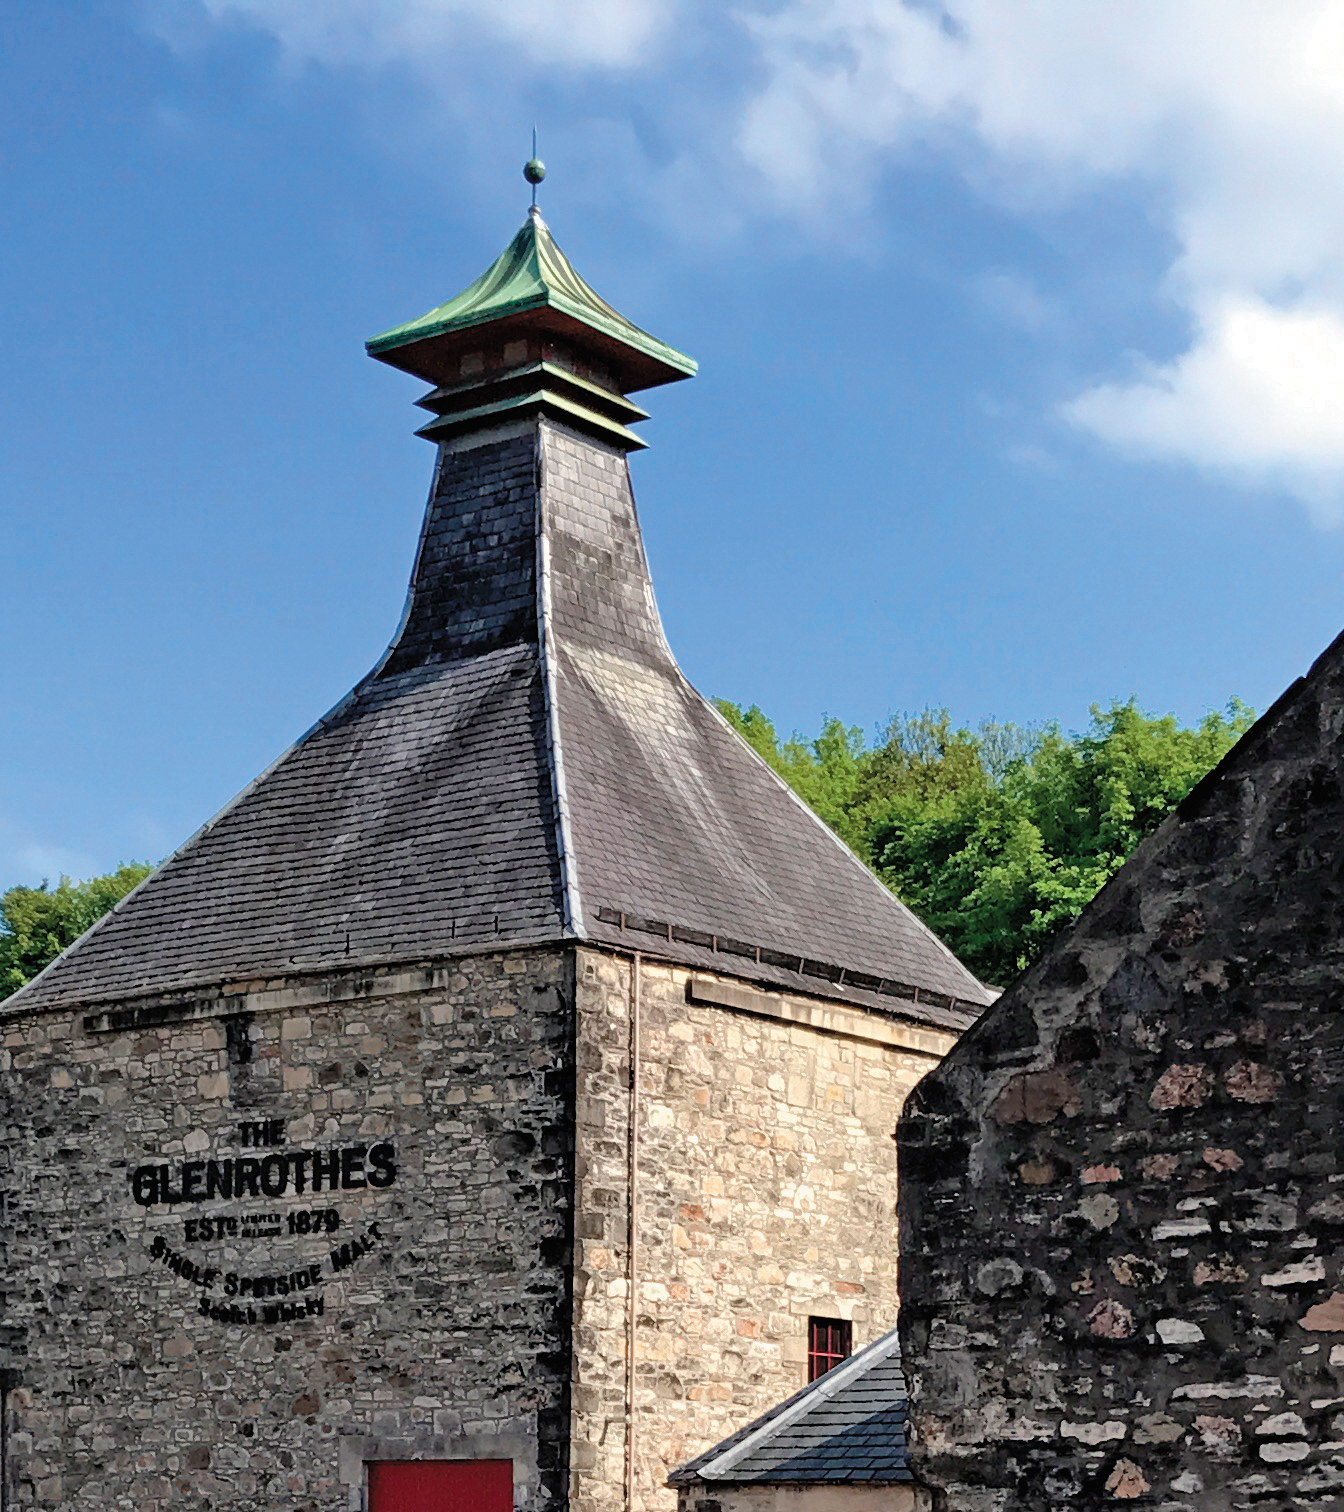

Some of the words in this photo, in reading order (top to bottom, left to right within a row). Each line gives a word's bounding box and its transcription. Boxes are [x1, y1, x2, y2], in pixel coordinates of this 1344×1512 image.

[238, 1119, 286, 1147] THE
[132, 1143, 397, 1207] GLENROTHES
[286, 1208, 340, 1236] 1879
[150, 1235, 222, 1290] SINGLE
[224, 1264, 324, 1299] SPEYSIDE
[330, 1221, 383, 1273] MALT
